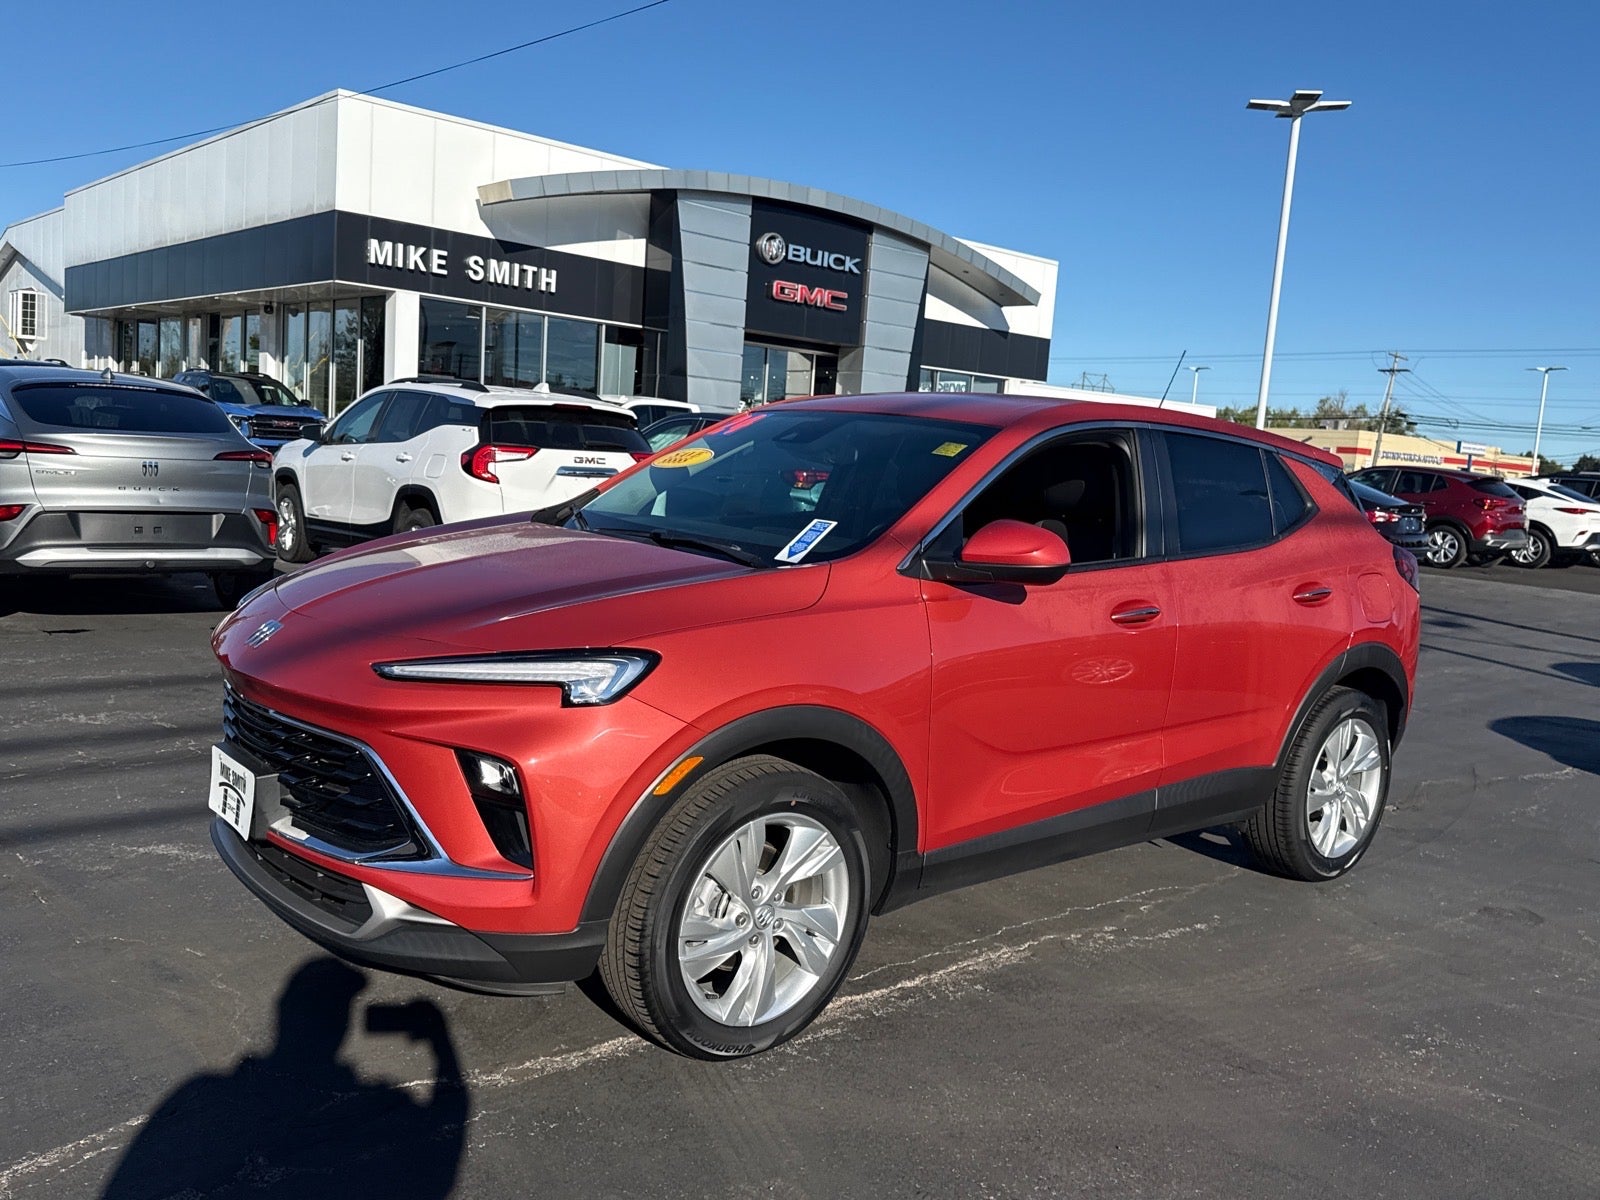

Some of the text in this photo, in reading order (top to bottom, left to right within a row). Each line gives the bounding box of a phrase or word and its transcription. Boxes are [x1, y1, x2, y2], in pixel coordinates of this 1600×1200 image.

[367, 238, 558, 294] MIKE SMITH
[787, 243, 862, 275] BUICK
[772, 279, 849, 312] GMC
[573, 456, 607, 465] GMC
